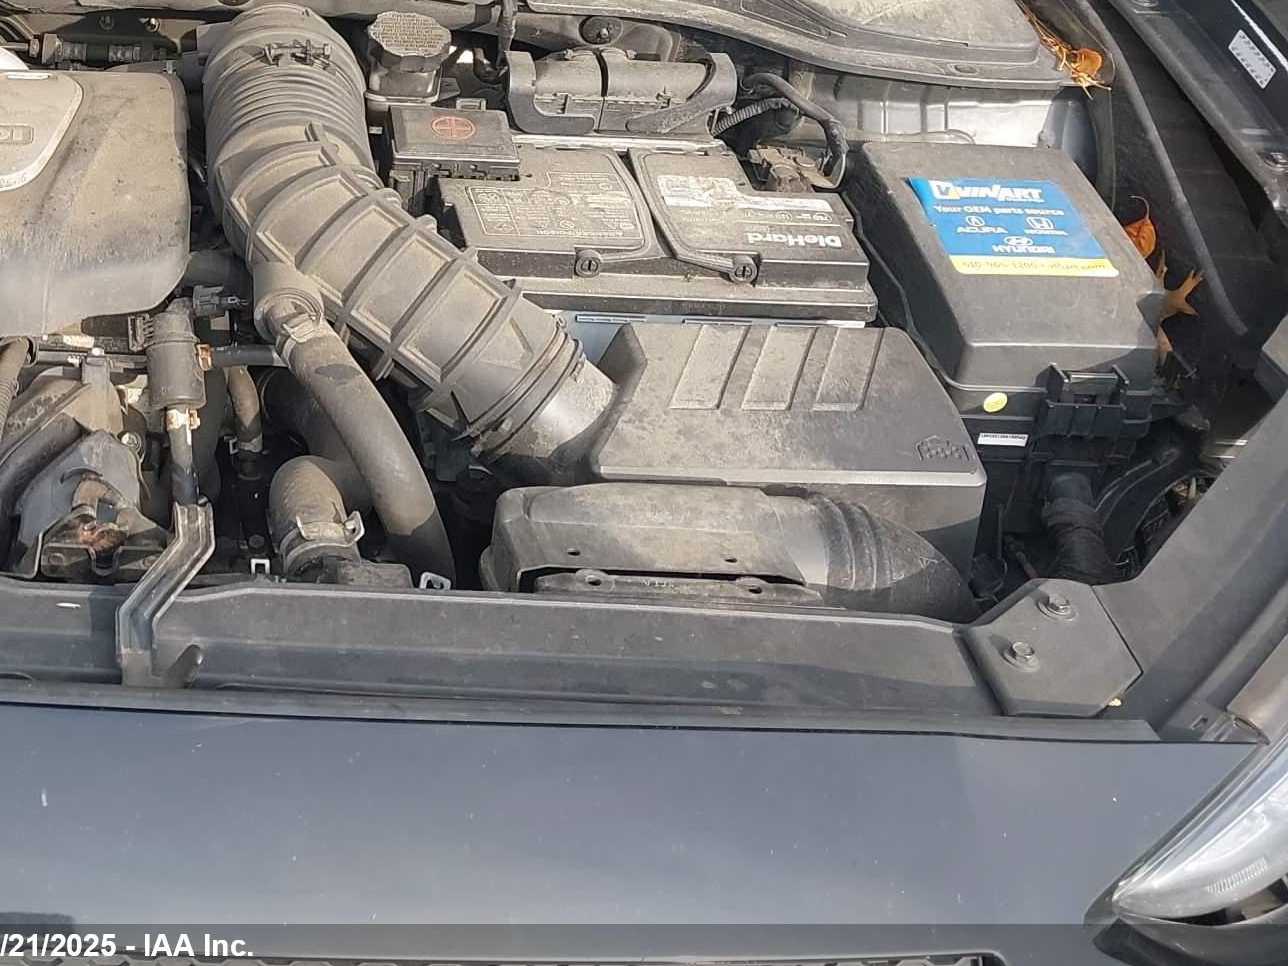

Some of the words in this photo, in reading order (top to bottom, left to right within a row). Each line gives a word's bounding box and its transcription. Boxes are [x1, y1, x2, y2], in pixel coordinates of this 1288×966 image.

[934, 205, 962, 214] Your
[963, 206, 992, 214] OEM
[993, 207, 1023, 216] parts
[1024, 208, 1065, 216] source
[956, 226, 1009, 234] ACURA
[747, 232, 843, 248] DieHard
[991, 244, 1056, 254] HYUNDAI
